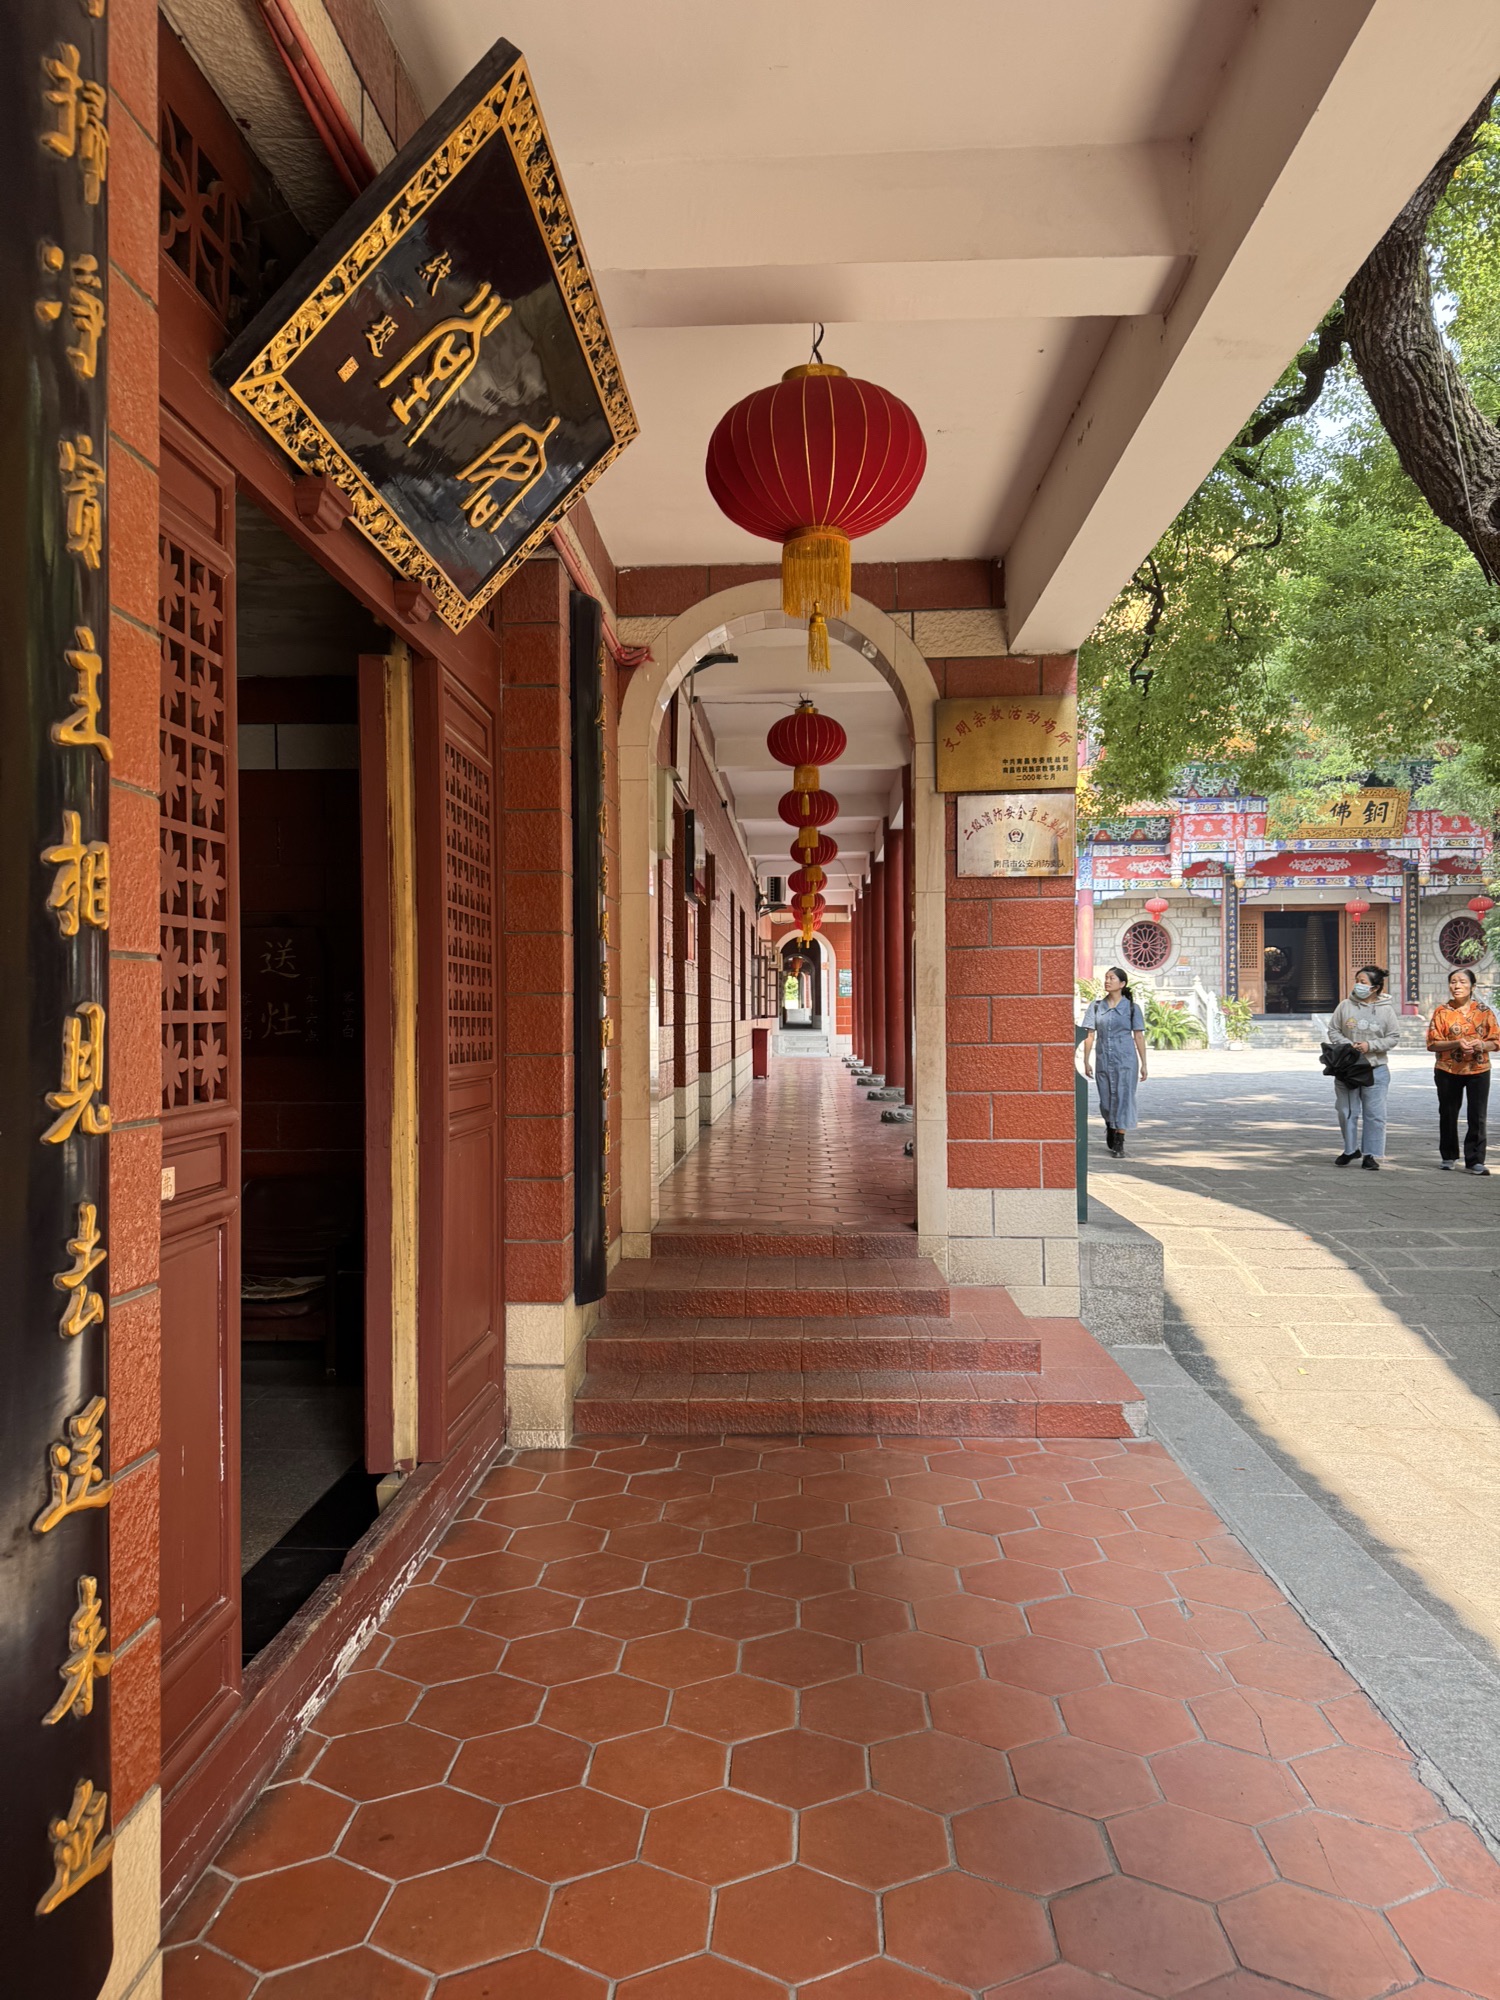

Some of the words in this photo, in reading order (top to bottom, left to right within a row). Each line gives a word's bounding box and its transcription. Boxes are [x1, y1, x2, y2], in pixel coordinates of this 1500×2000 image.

[943, 705, 1073, 752] 文明宗教活动场所
[1002, 764, 1069, 774] 南昌市民族宗教事务局
[963, 804, 1070, 841] 二级消防安全重点单位
[1299, 800, 1390, 826] 銅佛
[993, 859, 1066, 869] 南昌市公安消防支队
[259, 938, 302, 1040] 送灶
